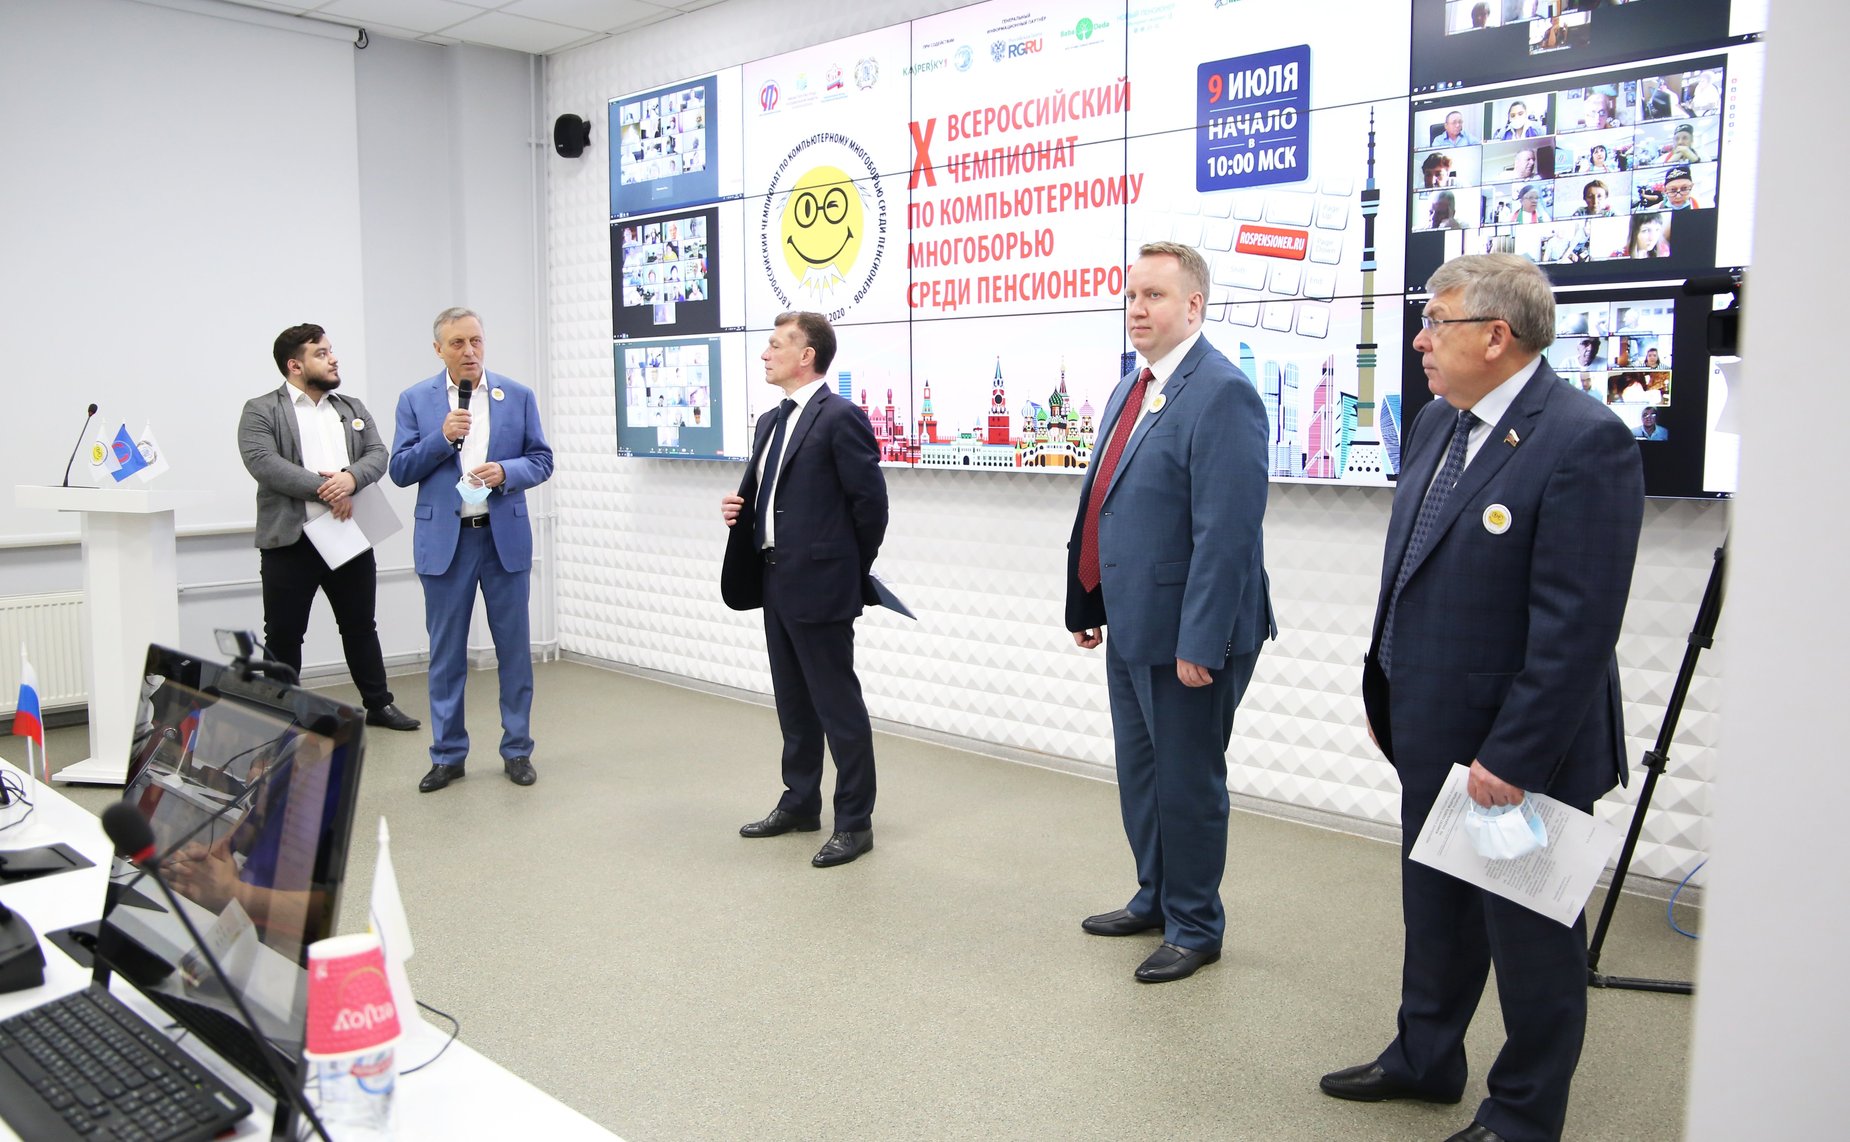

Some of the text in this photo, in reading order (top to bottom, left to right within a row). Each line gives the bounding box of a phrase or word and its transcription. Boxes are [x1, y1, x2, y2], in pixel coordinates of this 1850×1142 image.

[1008, 38, 1043, 58] RGRU
[1208, 61, 1298, 104] 9 ИЮЛЯ
[947, 76, 1131, 142] ВСЕРОССИЙСКИЙ
[1208, 106, 1297, 141] НАЧАЛО
[778, 159, 789, 172] ПО
[787, 132, 850, 161] КОМПЬЮТЕРНОМУ
[947, 135, 1078, 184] ЧЕМПИОНАТ
[1207, 145, 1297, 178] 10:00 МСК
[848, 140, 884, 198] МНОГОБОРЬЮ
[761, 170, 782, 231] ЧЕМПИОНАТ
[878, 199, 887, 234] СРЕДИ
[908, 173, 1145, 230] ПО КОМПЬЮТЕРНОМУ
[907, 227, 1055, 269] МНОГОБОРЬЮ
[1239, 231, 1305, 251] ROSPENSIONER.RU
[854, 236, 886, 304] ПЕНСИОНЕРОВ
[906, 264, 1133, 312] СРЕДИ ПЕНСИОНЕРО
[828, 308, 846, 322] 2020
[333, 1001, 395, 1032] enjoy
